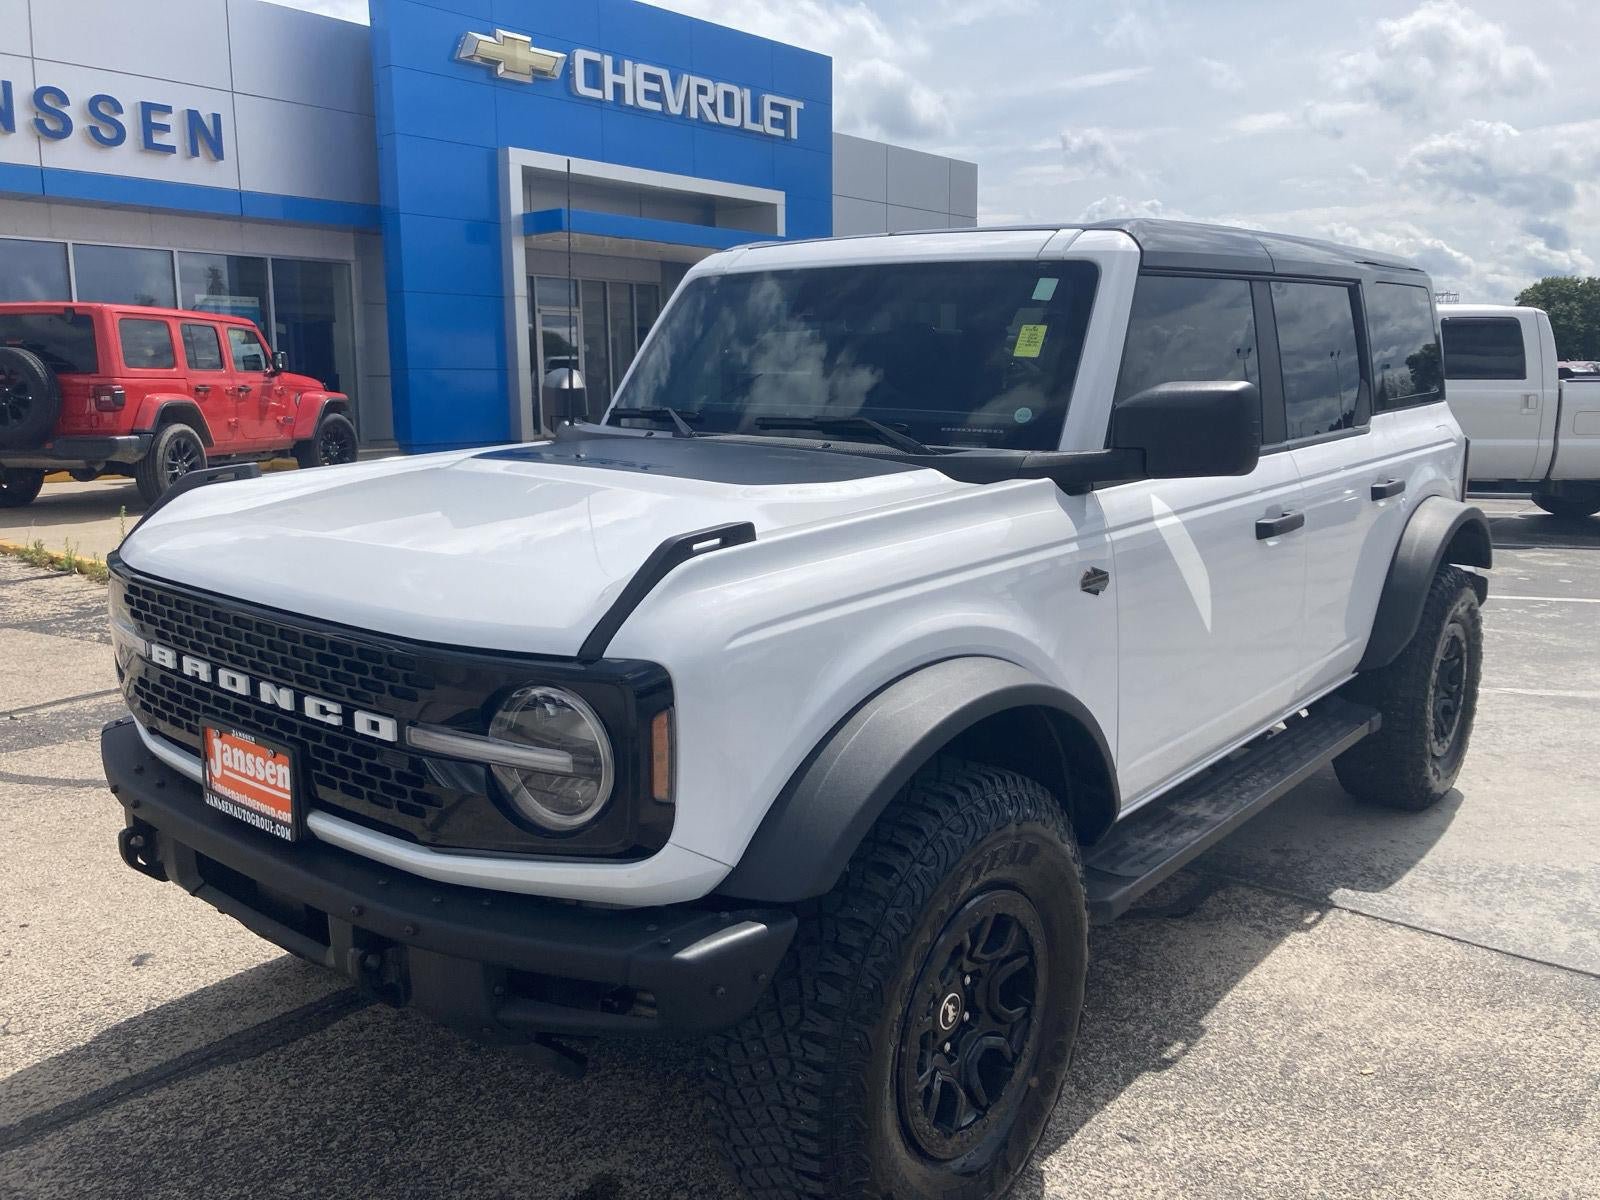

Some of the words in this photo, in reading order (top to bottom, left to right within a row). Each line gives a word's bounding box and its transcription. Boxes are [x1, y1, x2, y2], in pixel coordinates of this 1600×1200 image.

[570, 48, 804, 141] CHEVROLET
[152, 643, 398, 742] BRONCO
[210, 738, 291, 790] Janssen
[205, 792, 292, 841] JANSSENAUTOGROUP.COM
